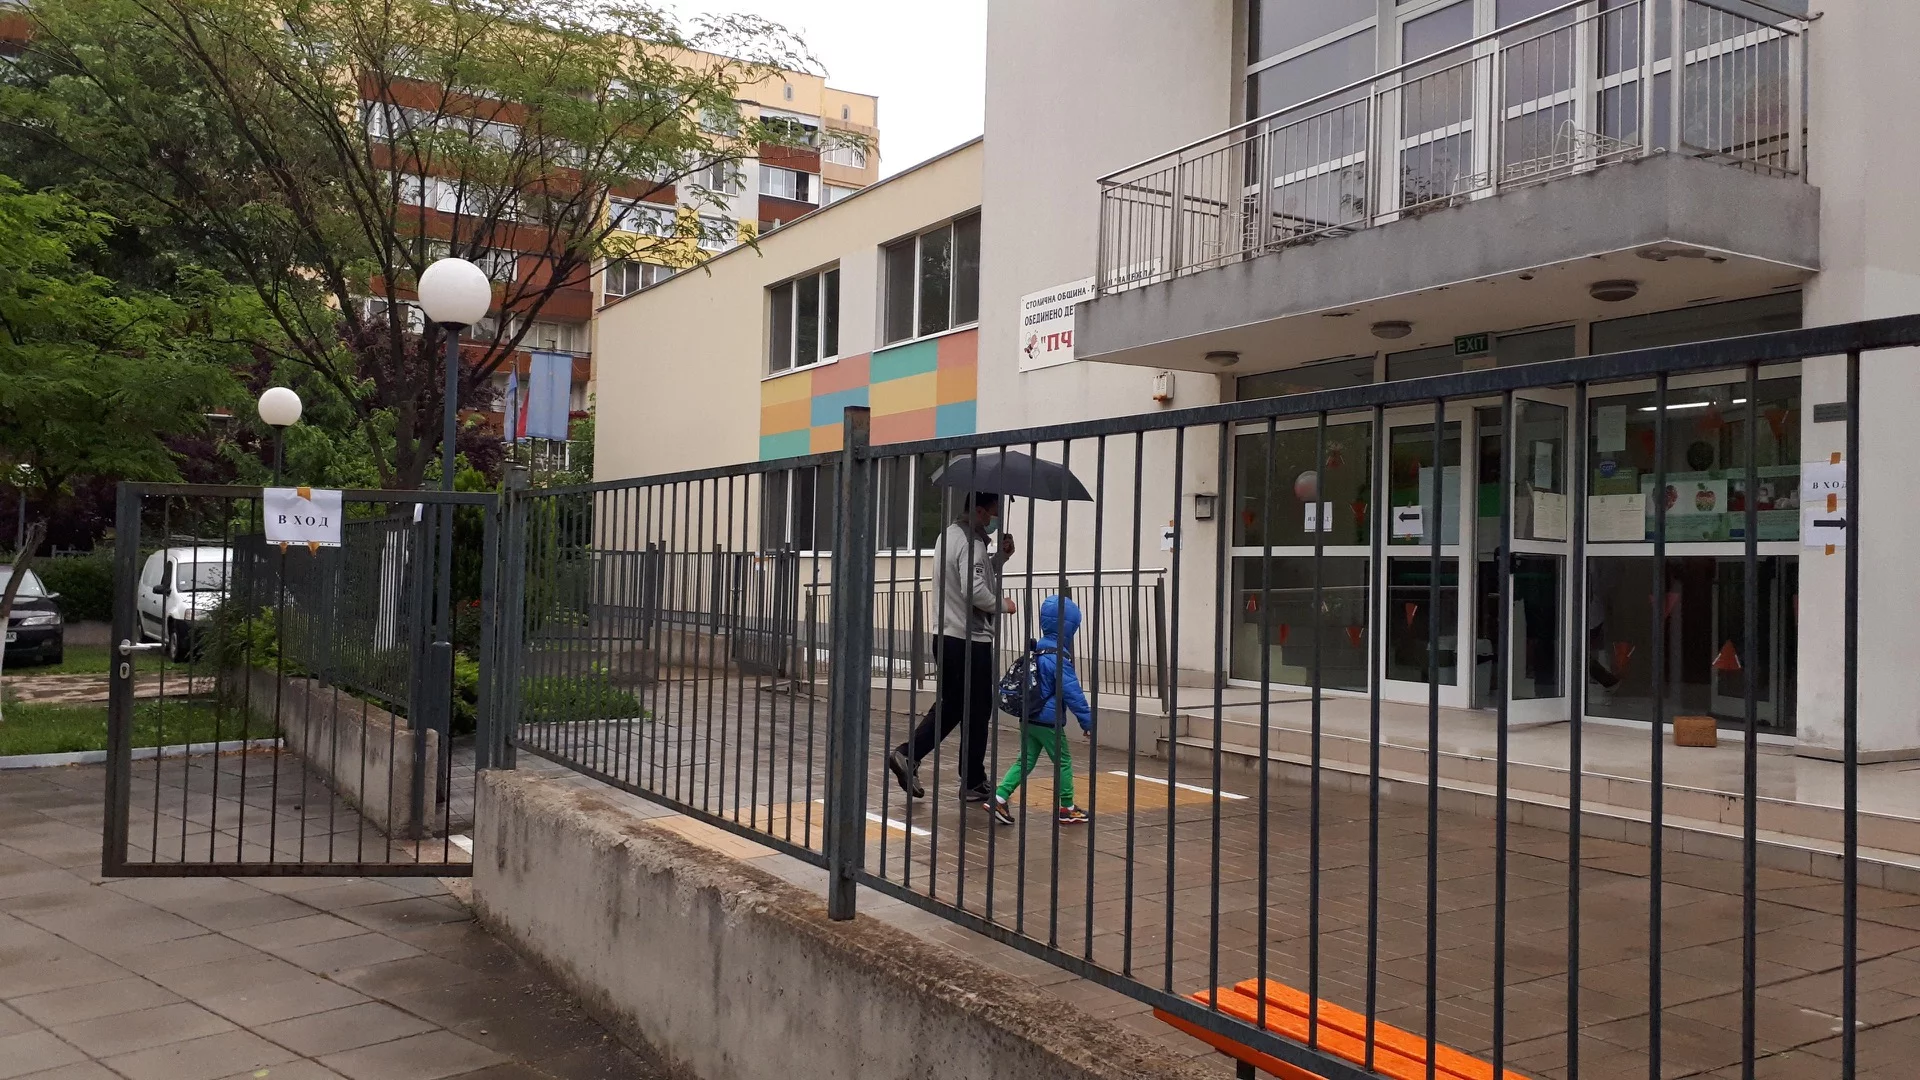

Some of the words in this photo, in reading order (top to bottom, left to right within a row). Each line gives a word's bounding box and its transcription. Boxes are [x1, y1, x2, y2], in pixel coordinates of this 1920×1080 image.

[1025, 294, 1056, 310] СТОЛИЧНА
[1057, 287, 1087, 302] ОБЩИНА
[1024, 307, 1063, 327] ОБЕДИНЕНО
[1064, 304, 1075, 318] ДЕ
[1041, 330, 1073, 352] "ПЧ
[1457, 336, 1485, 353] EXIT
[278, 514, 329, 528] ВХОД
